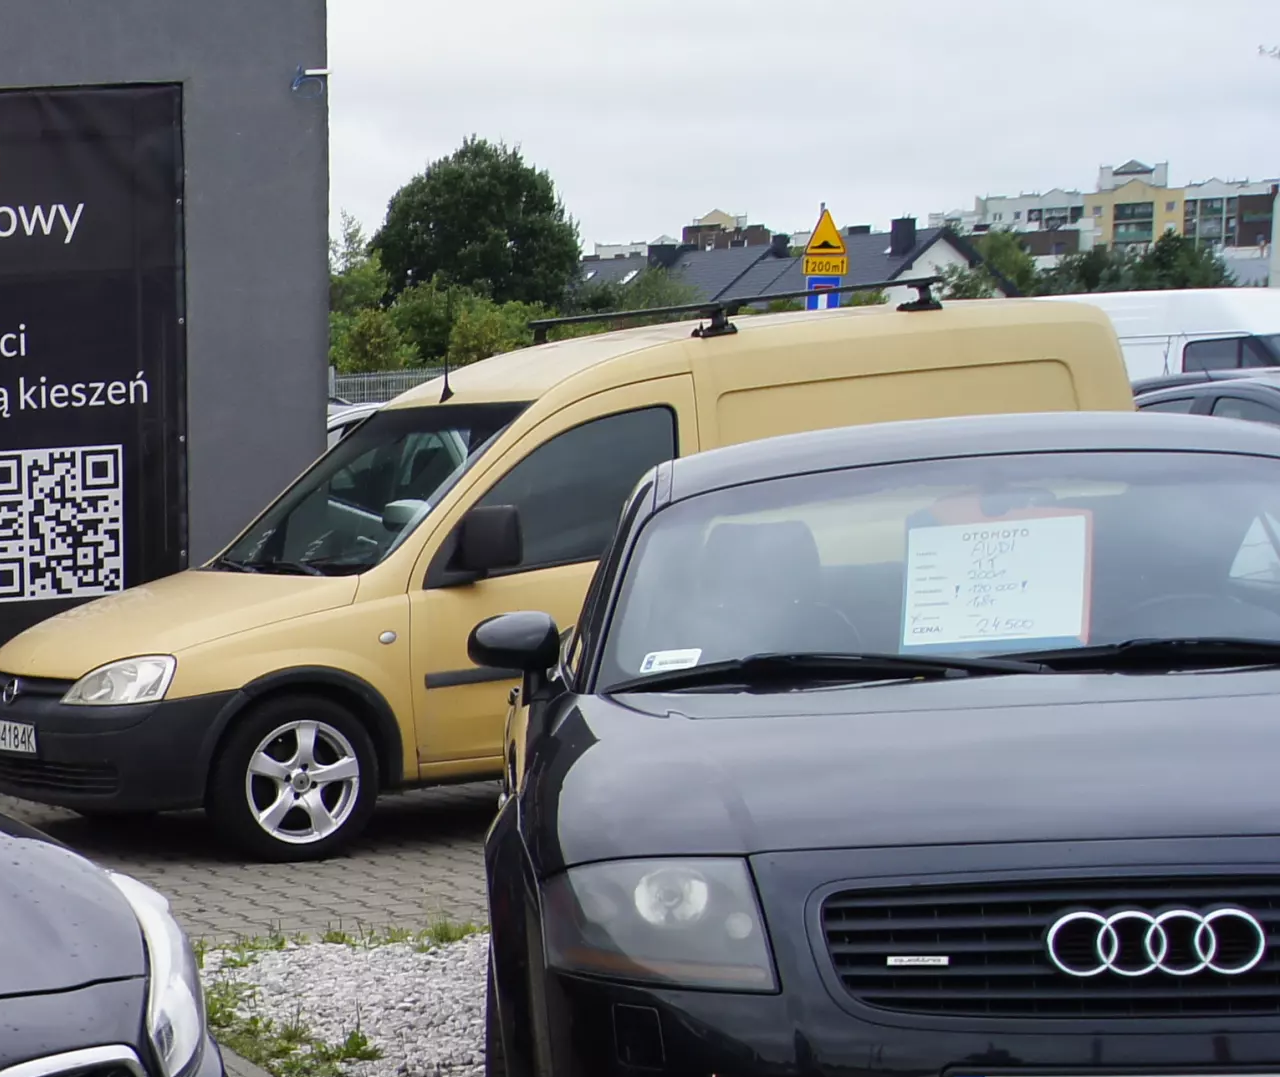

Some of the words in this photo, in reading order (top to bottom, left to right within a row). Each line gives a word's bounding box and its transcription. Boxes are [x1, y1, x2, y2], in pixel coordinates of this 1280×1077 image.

[19, 370, 149, 410] kieszeń
[962, 528, 1030, 542] OTOMOTO
[970, 540, 1016, 557] AUDI
[0, 723, 35, 752] 4184K
